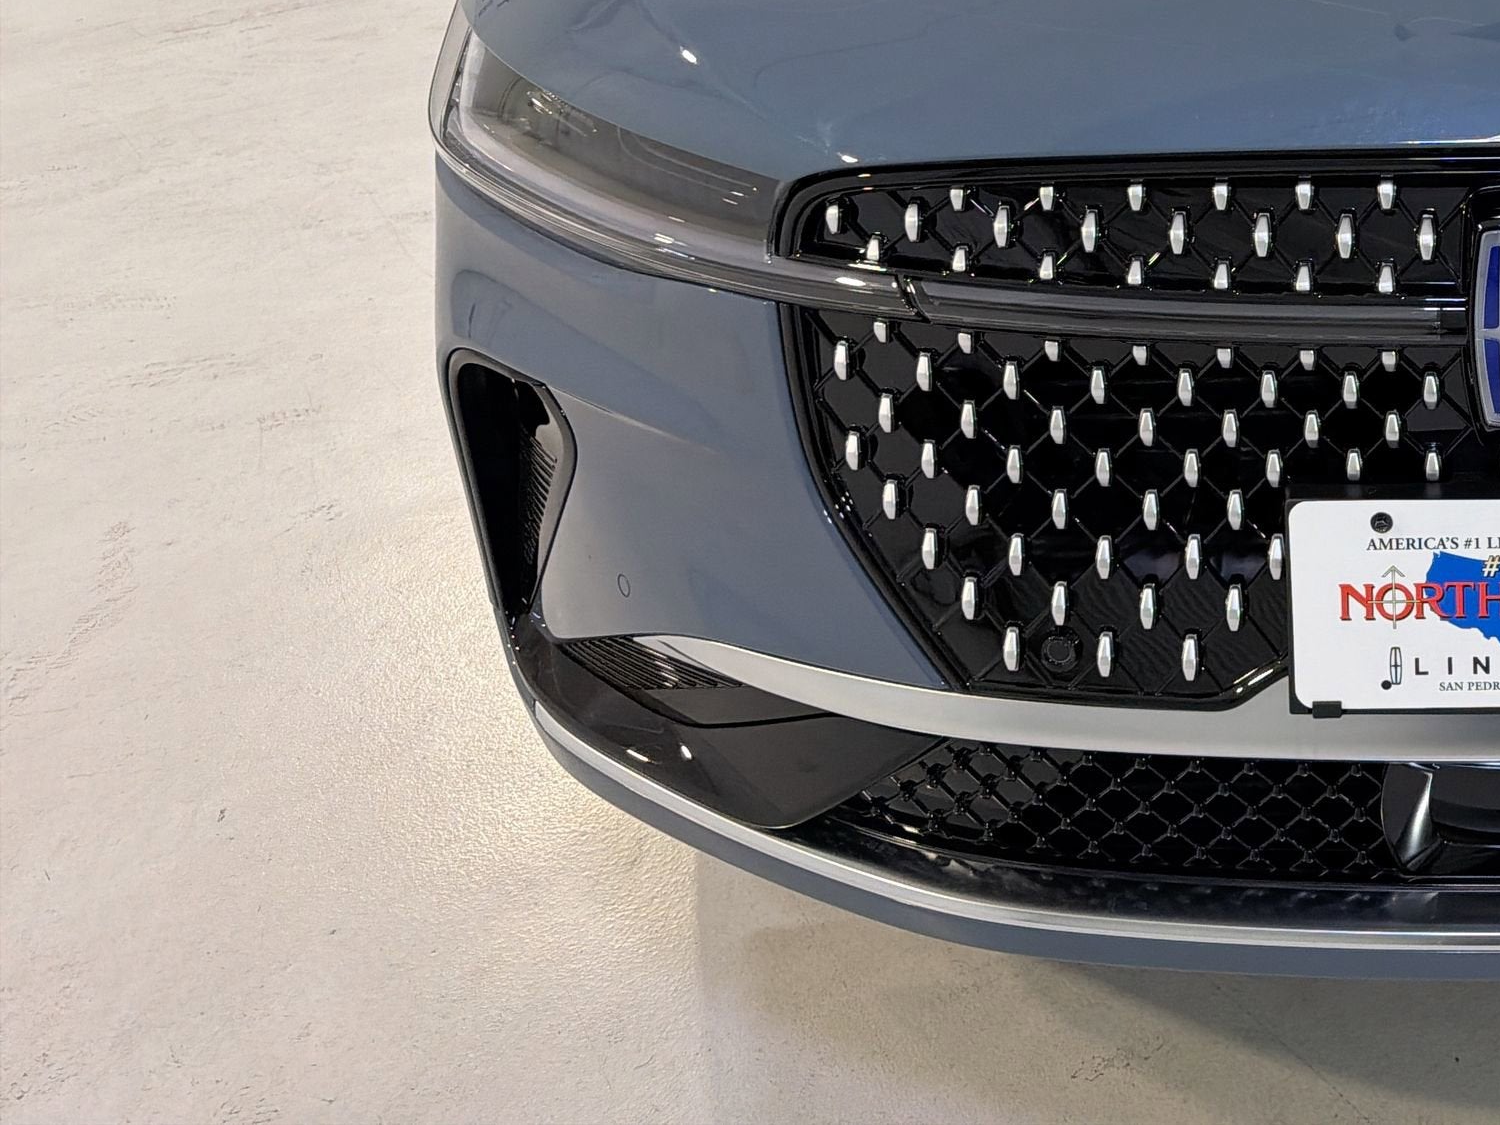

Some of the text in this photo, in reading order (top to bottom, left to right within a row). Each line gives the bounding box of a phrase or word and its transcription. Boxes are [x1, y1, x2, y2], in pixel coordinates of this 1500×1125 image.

[1366, 536, 1459, 551] AMERICA'S
[1463, 537, 1481, 550] #1
[1439, 682, 1464, 692] SAN
